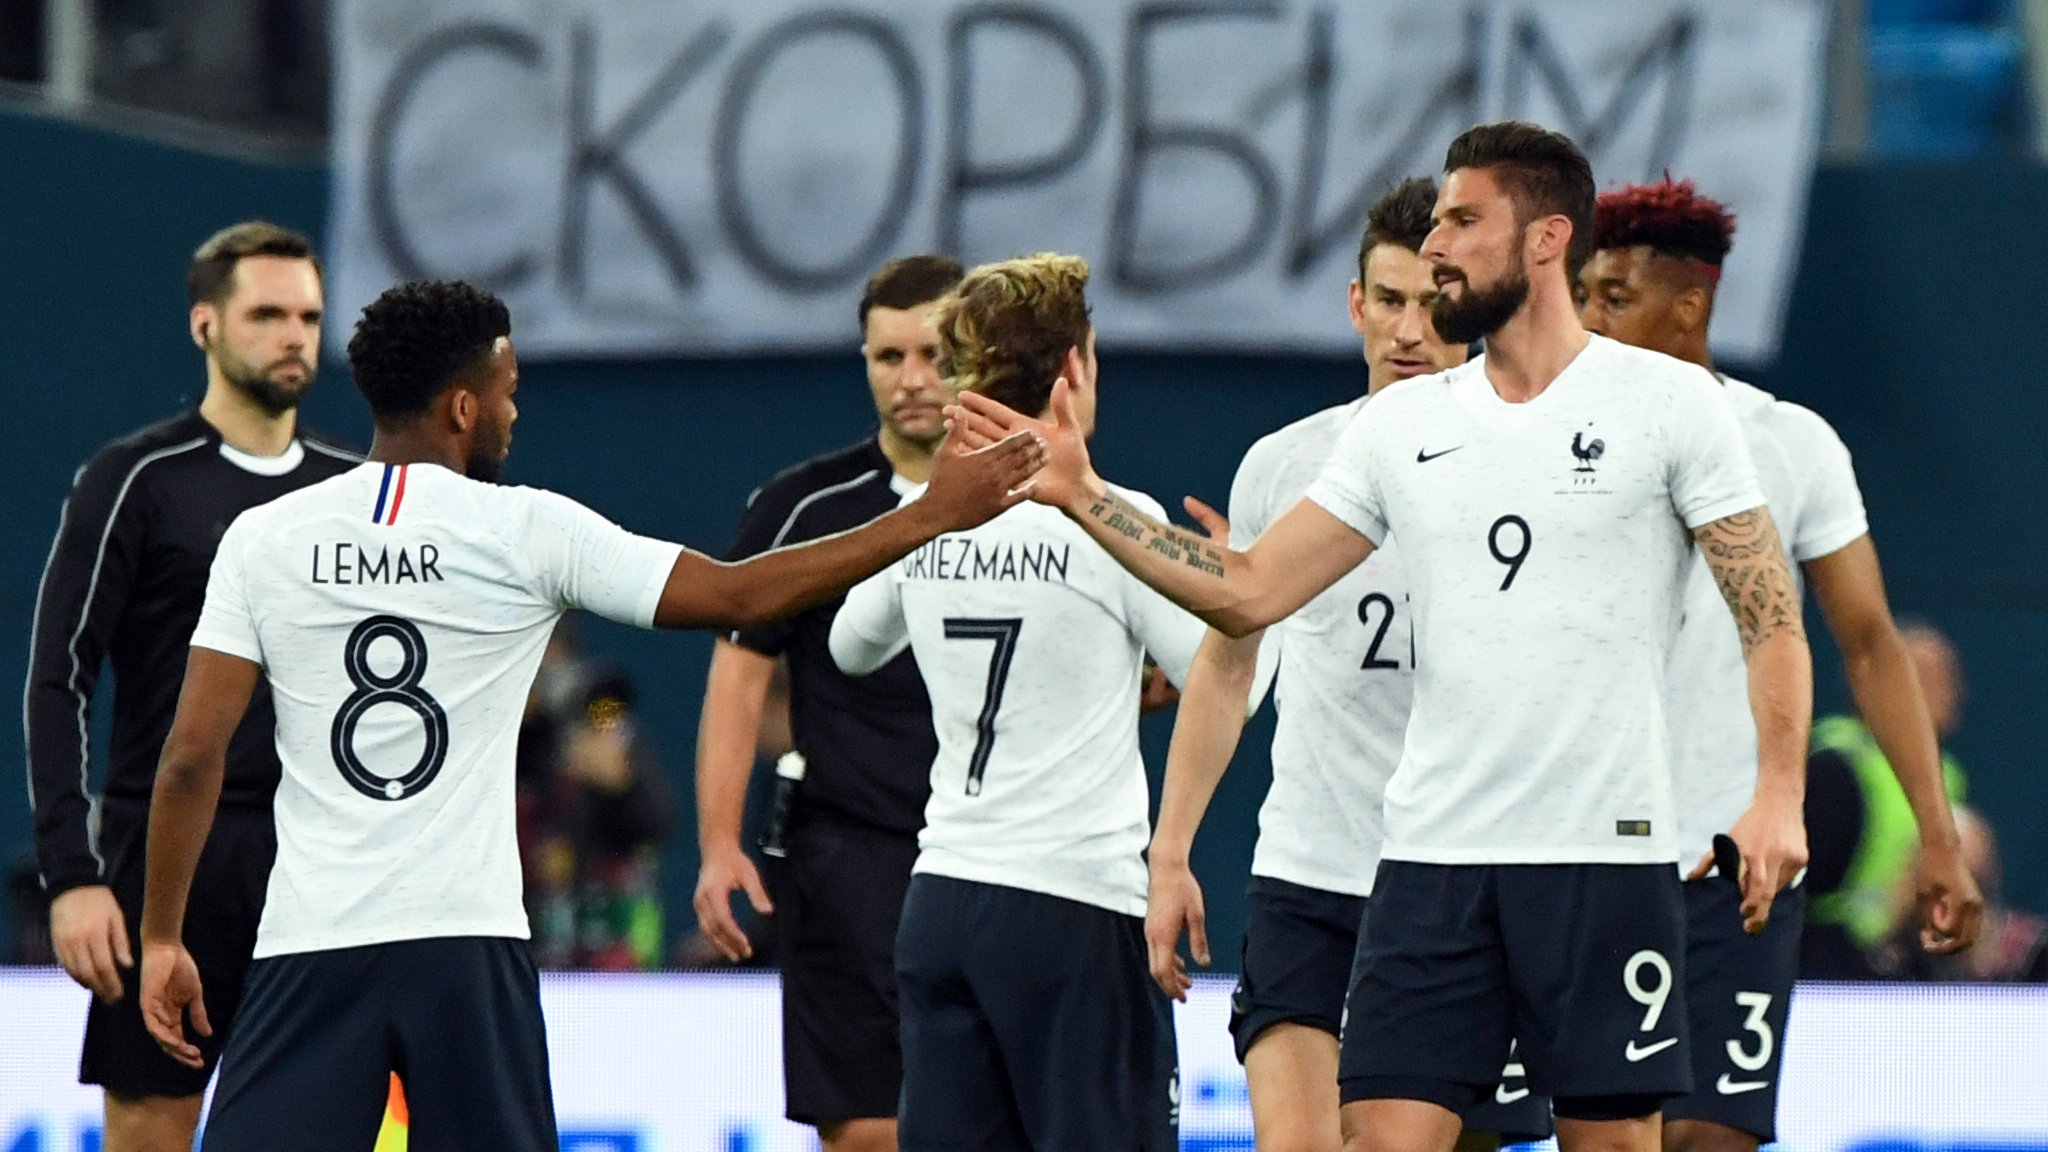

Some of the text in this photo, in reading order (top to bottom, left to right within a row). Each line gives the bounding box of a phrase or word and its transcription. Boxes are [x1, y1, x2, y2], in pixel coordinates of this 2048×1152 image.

[366, 1, 1698, 294] СКОРБИМ
[311, 542, 444, 586] LEMAR
[1488, 514, 1532, 591] 9
[331, 614, 449, 801] 8
[943, 617, 1023, 796] 7
[1623, 949, 1673, 1032] 9
[1725, 991, 1774, 1071] 3
